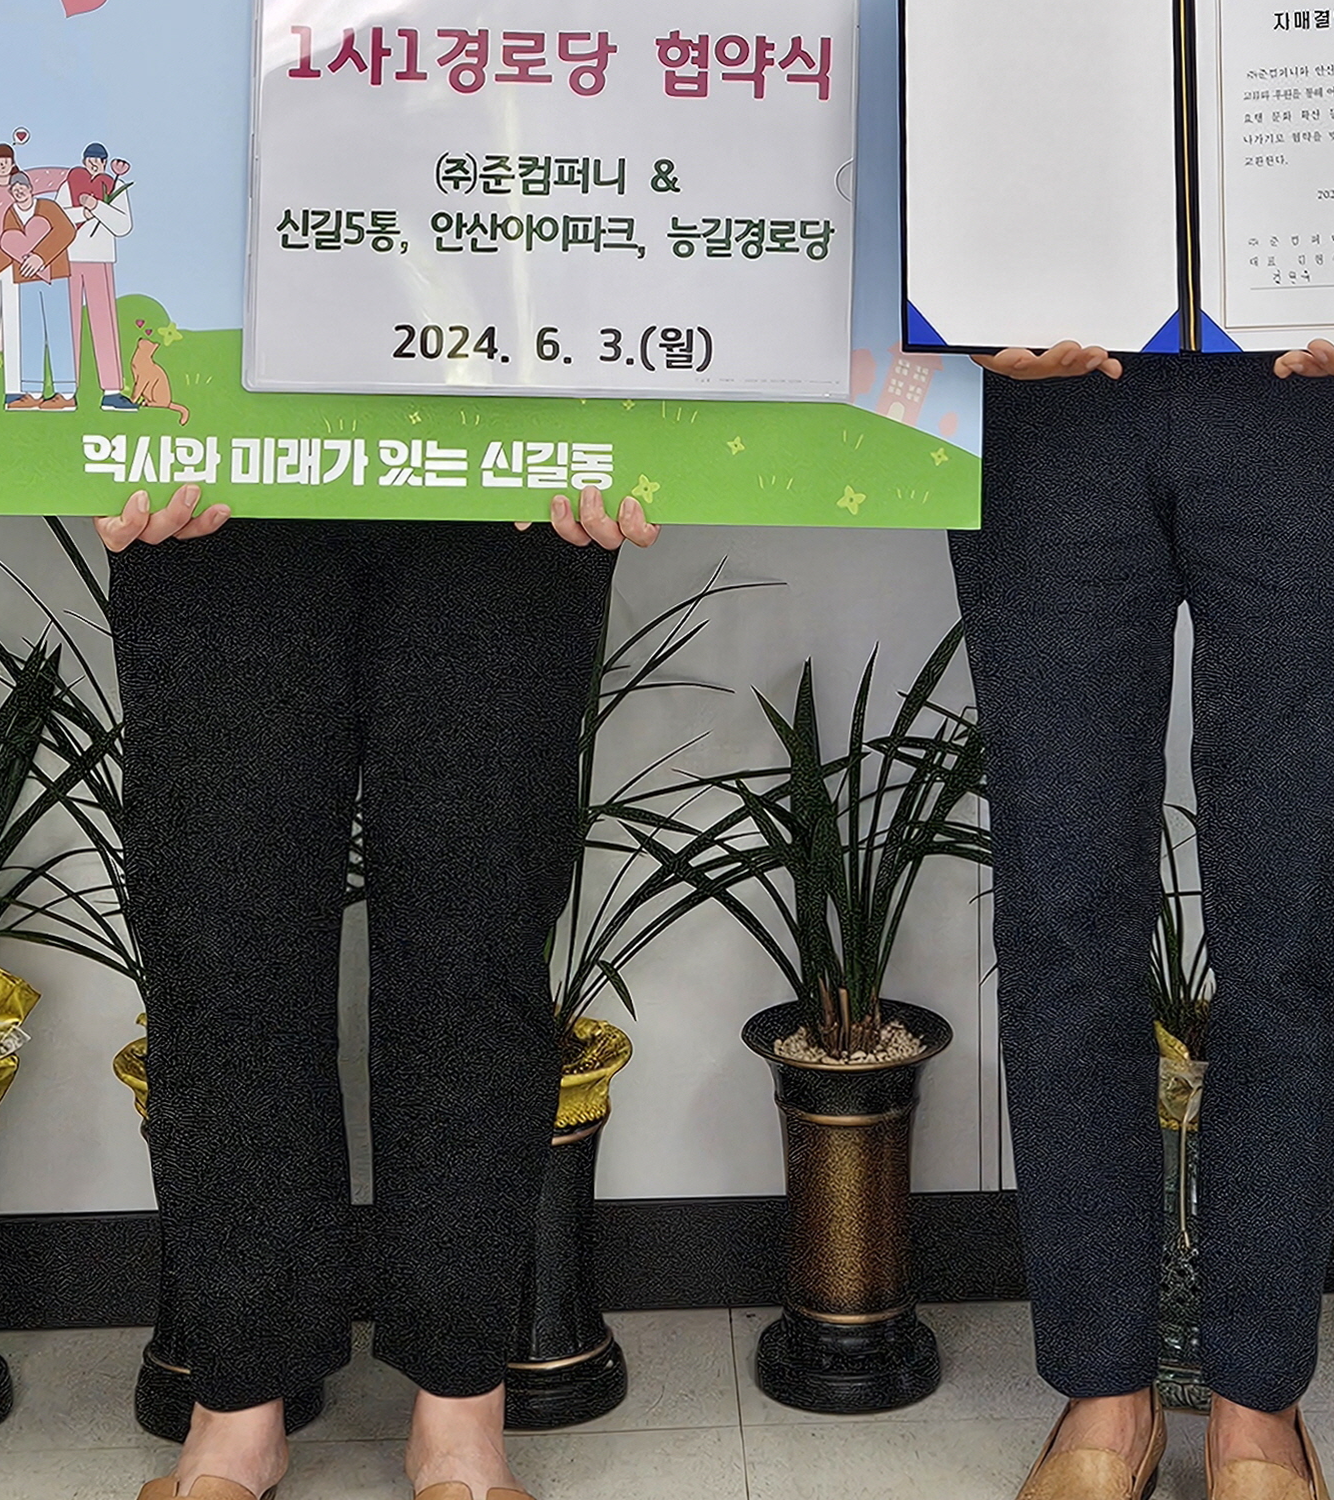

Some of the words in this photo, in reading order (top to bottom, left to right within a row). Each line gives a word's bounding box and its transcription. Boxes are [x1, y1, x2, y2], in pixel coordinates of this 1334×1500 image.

[287, 24, 618, 98] 1사1경로당
[655, 28, 833, 101] 협약식
[650, 159, 681, 193] &
[276, 209, 411, 255] 신길5통,
[431, 211, 646, 259] 안산아이파크,
[667, 217, 835, 261] 능길경로당
[392, 324, 510, 362] 2024.
[537, 328, 573, 365] 6.
[599, 327, 714, 372] 3.(월)
[82, 434, 221, 484] 역사와
[231, 439, 369, 487] 미래가
[378, 440, 468, 488] 있는
[480, 441, 614, 491] 신길동
